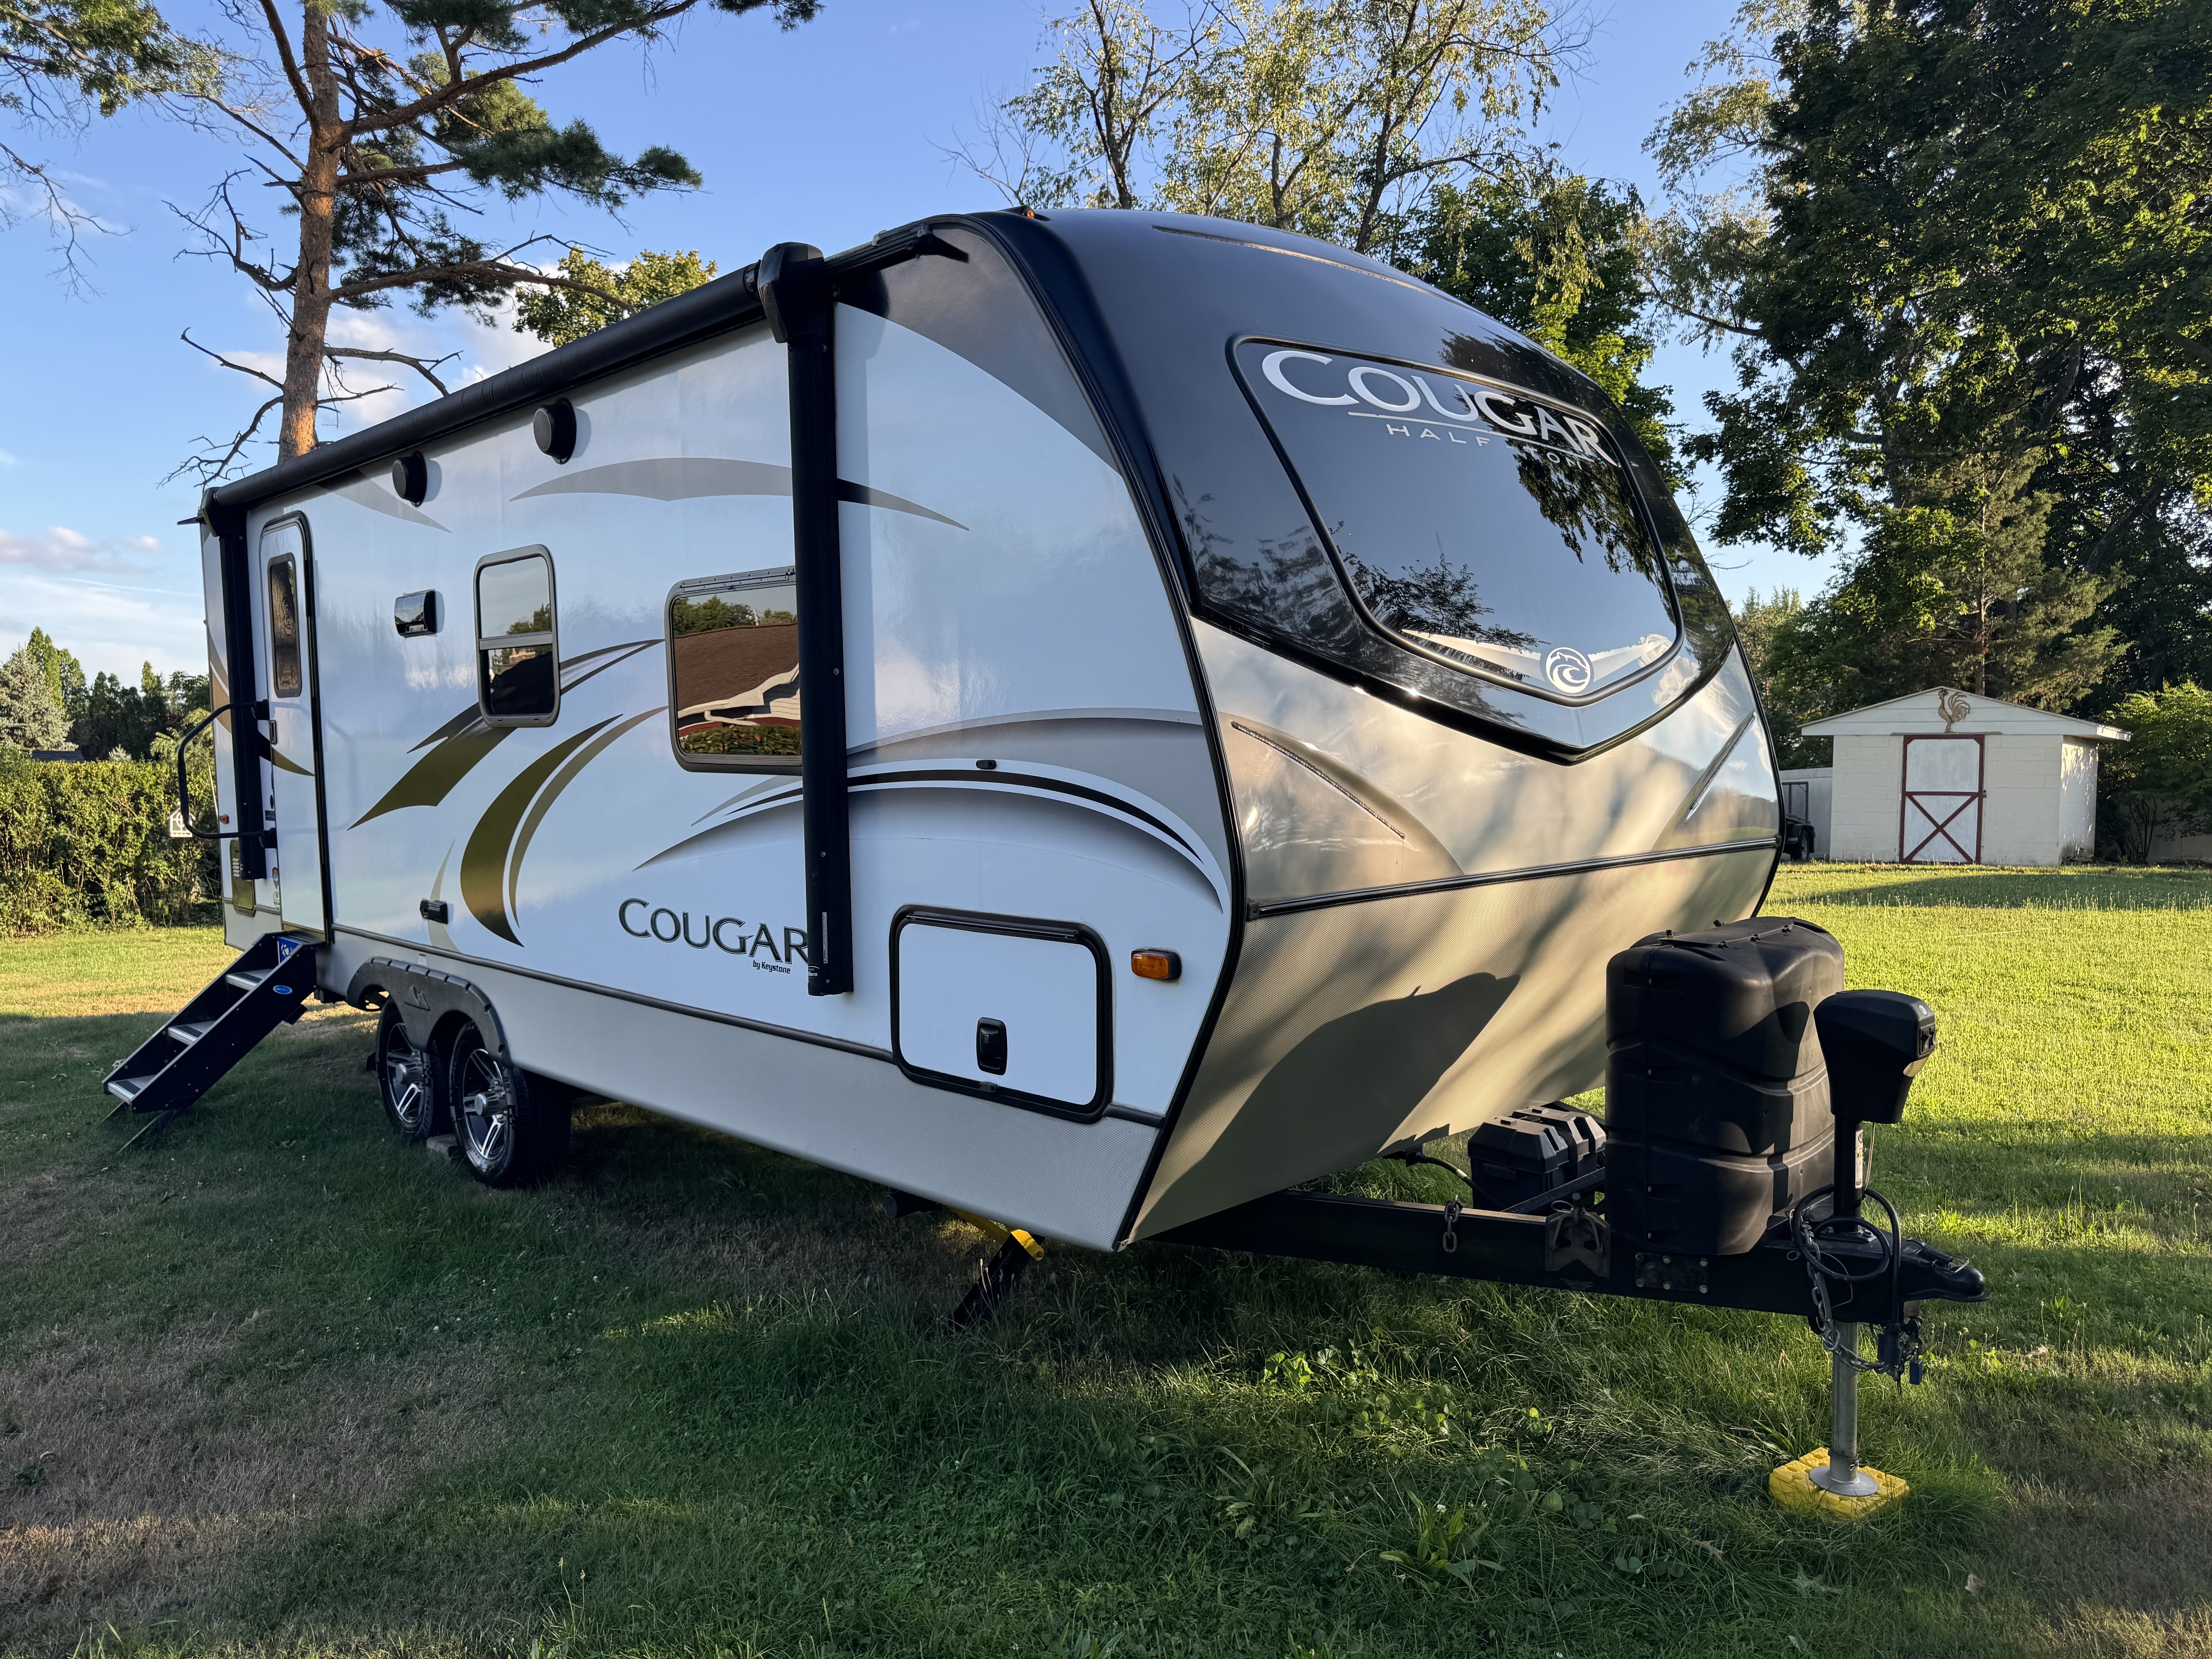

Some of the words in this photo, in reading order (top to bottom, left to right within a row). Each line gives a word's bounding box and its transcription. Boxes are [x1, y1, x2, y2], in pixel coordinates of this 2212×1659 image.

[1262, 350, 1618, 467] COUGAR
[619, 898, 808, 965] COUGAR
[753, 960, 761, 970] by
[761, 961, 791, 974] Keystone
